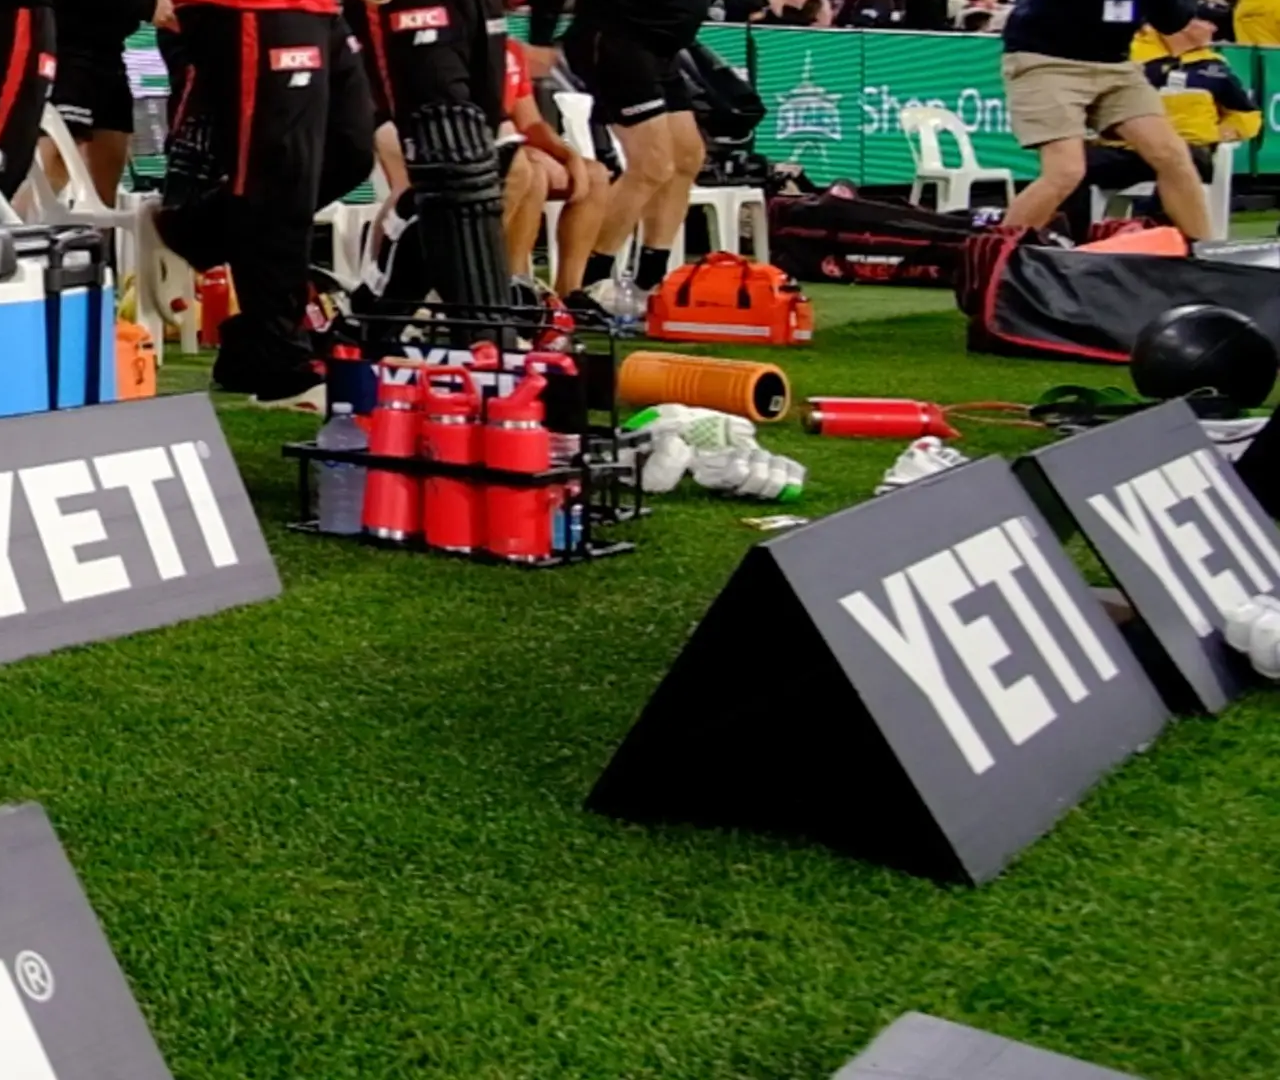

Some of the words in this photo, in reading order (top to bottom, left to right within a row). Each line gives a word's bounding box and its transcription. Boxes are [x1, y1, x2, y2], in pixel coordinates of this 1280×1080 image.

[400, 10, 441, 27] KFC
[279, 52, 316, 67] KFC
[857, 85, 947, 134] Sh
[1086, 448, 1280, 638] YETI
[837, 515, 1121, 776] YETI
